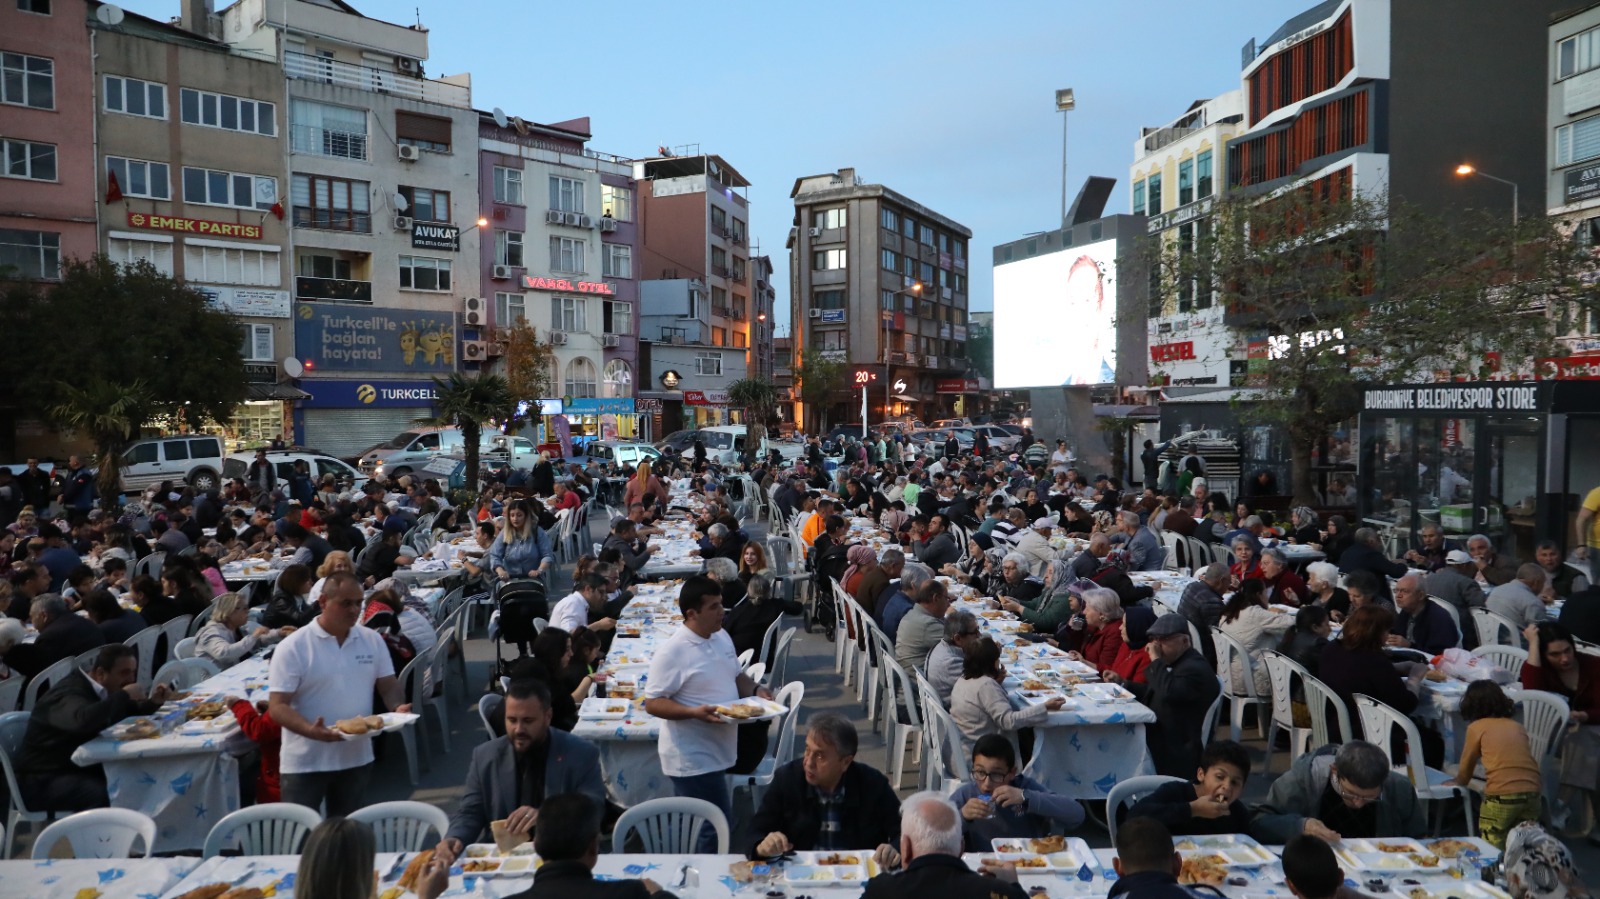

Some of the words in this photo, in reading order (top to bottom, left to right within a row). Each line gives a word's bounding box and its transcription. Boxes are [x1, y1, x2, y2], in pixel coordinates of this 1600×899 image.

[149, 216, 195, 231] EMEK
[415, 225, 458, 239] AVUKAT
[577, 281, 613, 294] OTEL
[322, 329, 376, 346] bağlan
[322, 345, 382, 362] hayata!
[855, 371, 869, 383] 20
[380, 388, 440, 400] TURKCELL
[1497, 387, 1537, 409] STORE
[635, 398, 663, 409] OTEL
